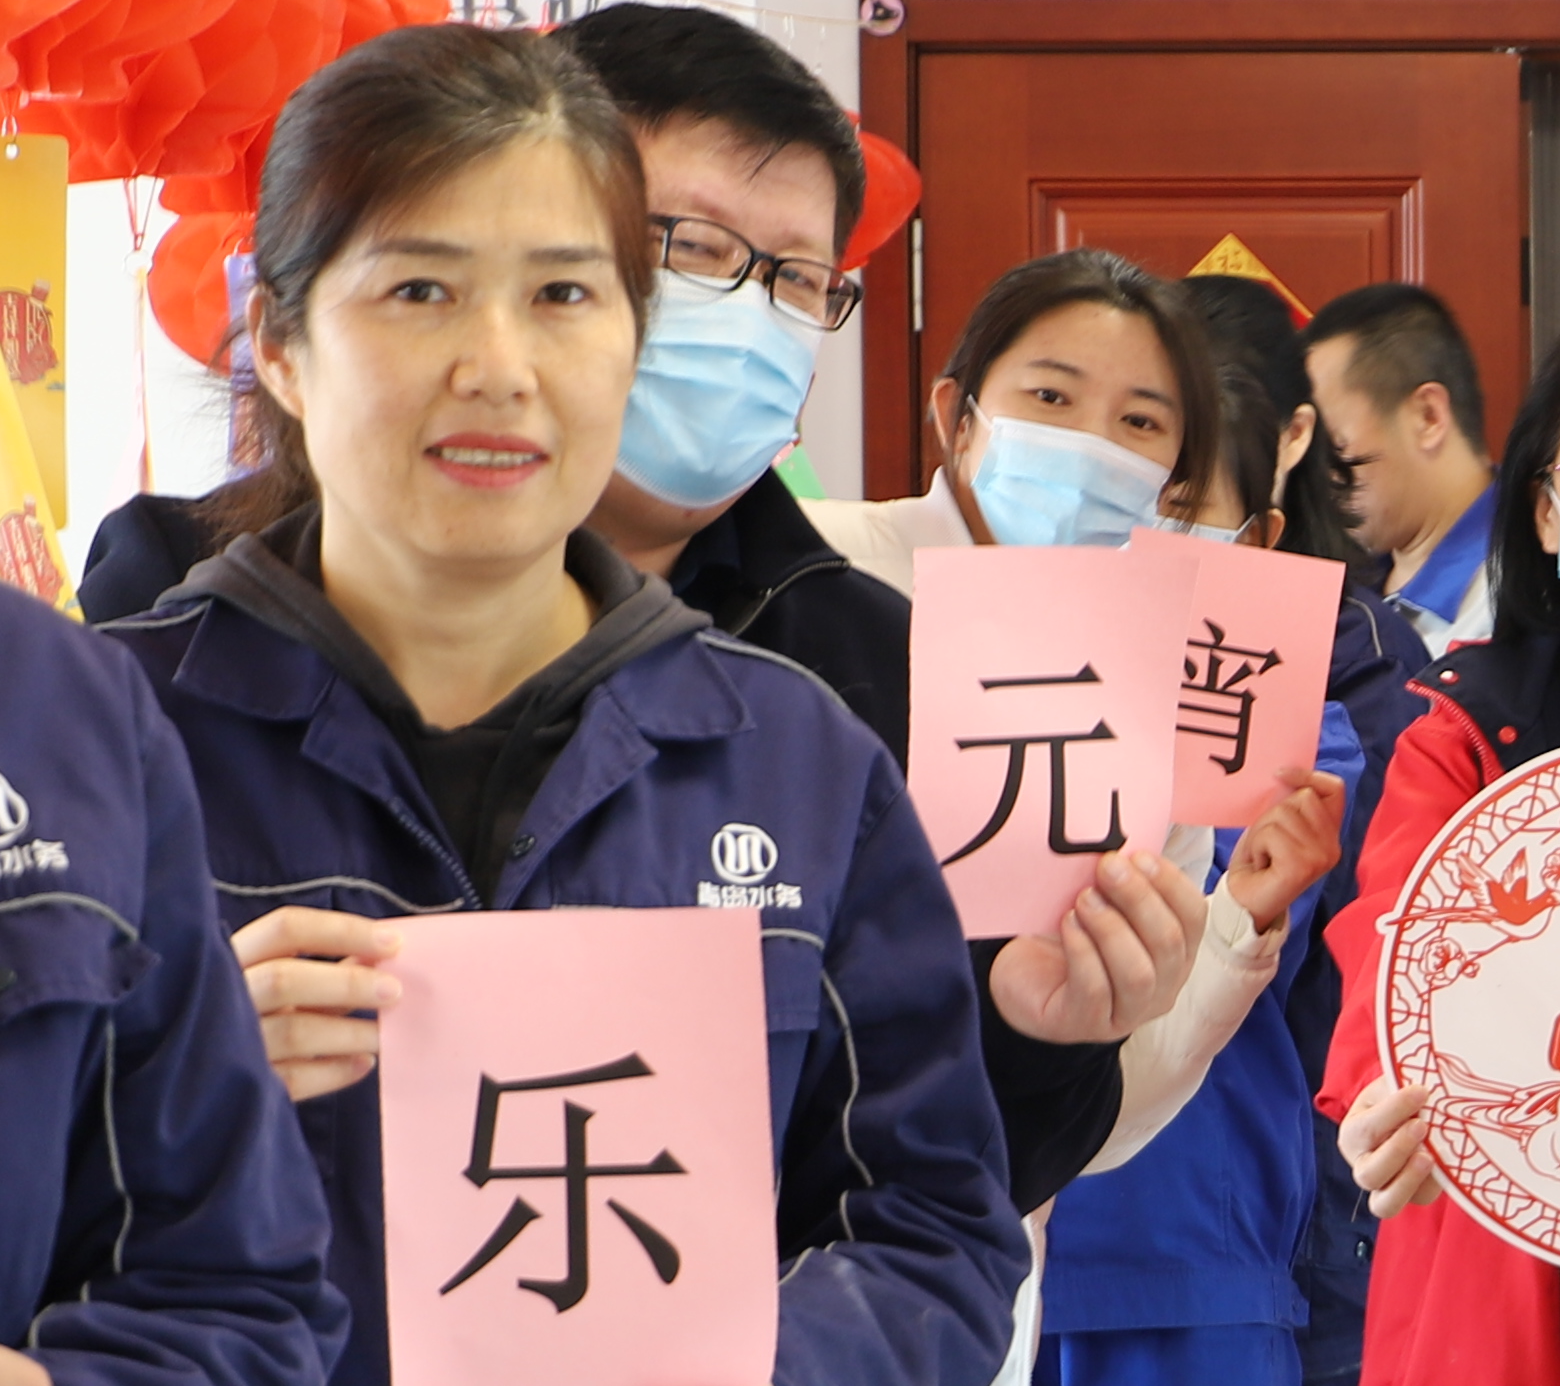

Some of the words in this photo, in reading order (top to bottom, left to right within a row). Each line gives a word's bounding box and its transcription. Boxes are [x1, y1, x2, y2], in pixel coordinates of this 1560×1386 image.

[942, 661, 1128, 868] 元
[1175, 618, 1283, 776] 宵
[438, 1051, 690, 1315] 乐
